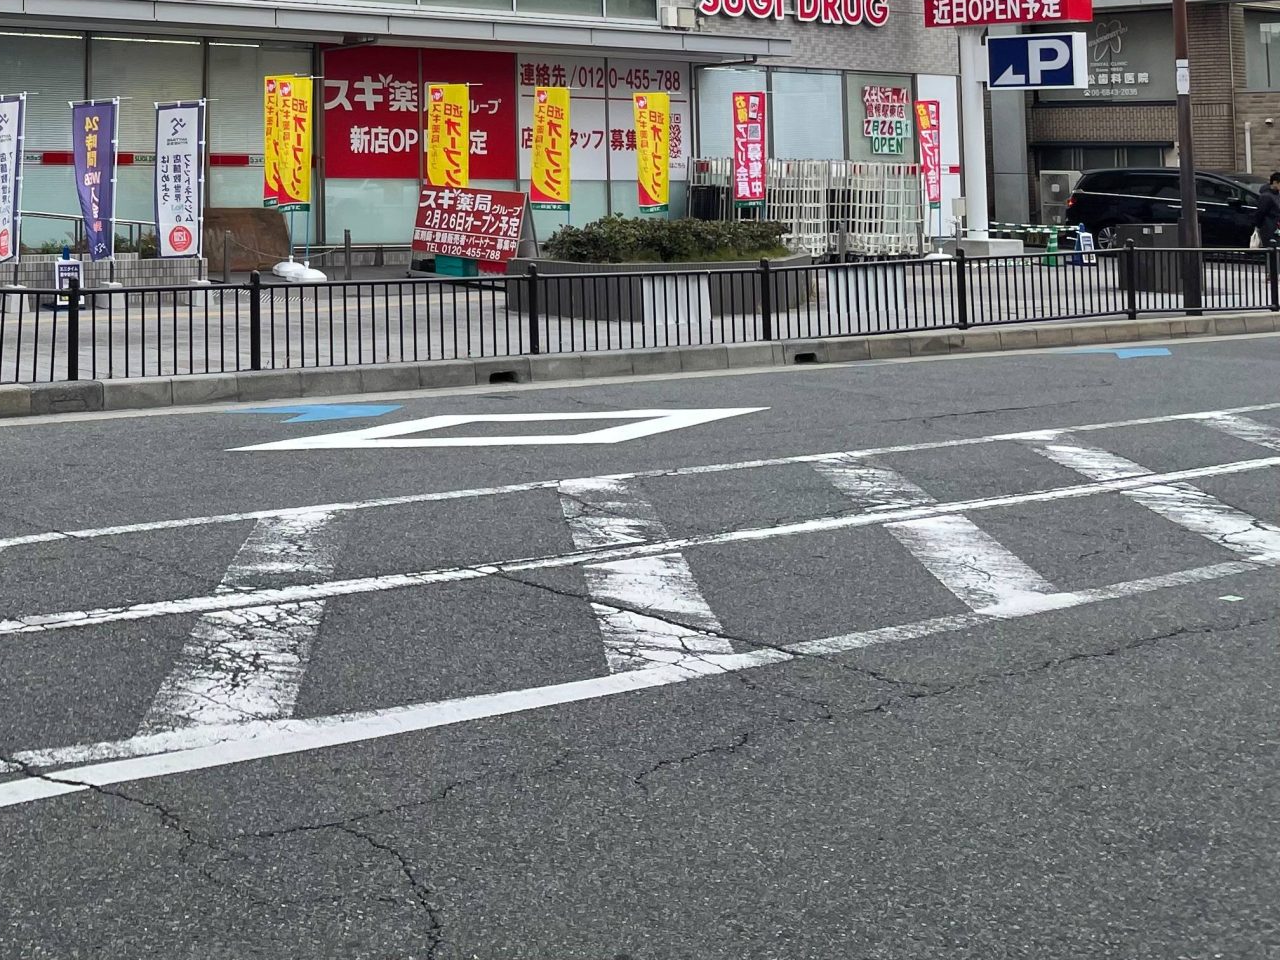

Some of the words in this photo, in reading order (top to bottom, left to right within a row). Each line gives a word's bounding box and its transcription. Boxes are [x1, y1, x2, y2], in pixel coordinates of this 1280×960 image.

[520, 63, 567, 87] 連絡先
[1027, 39, 1071, 85] P
[873, 136, 903, 154] OPEN
[735, 124, 751, 198] アプリ会員
[747, 143, 763, 197] 募集中
[419, 188, 492, 214] スギ薬局
[424, 209, 520, 237] 2月26日オープン予定
[426, 242, 440, 253] TEL
[441, 244, 501, 260] 0120-455-788
